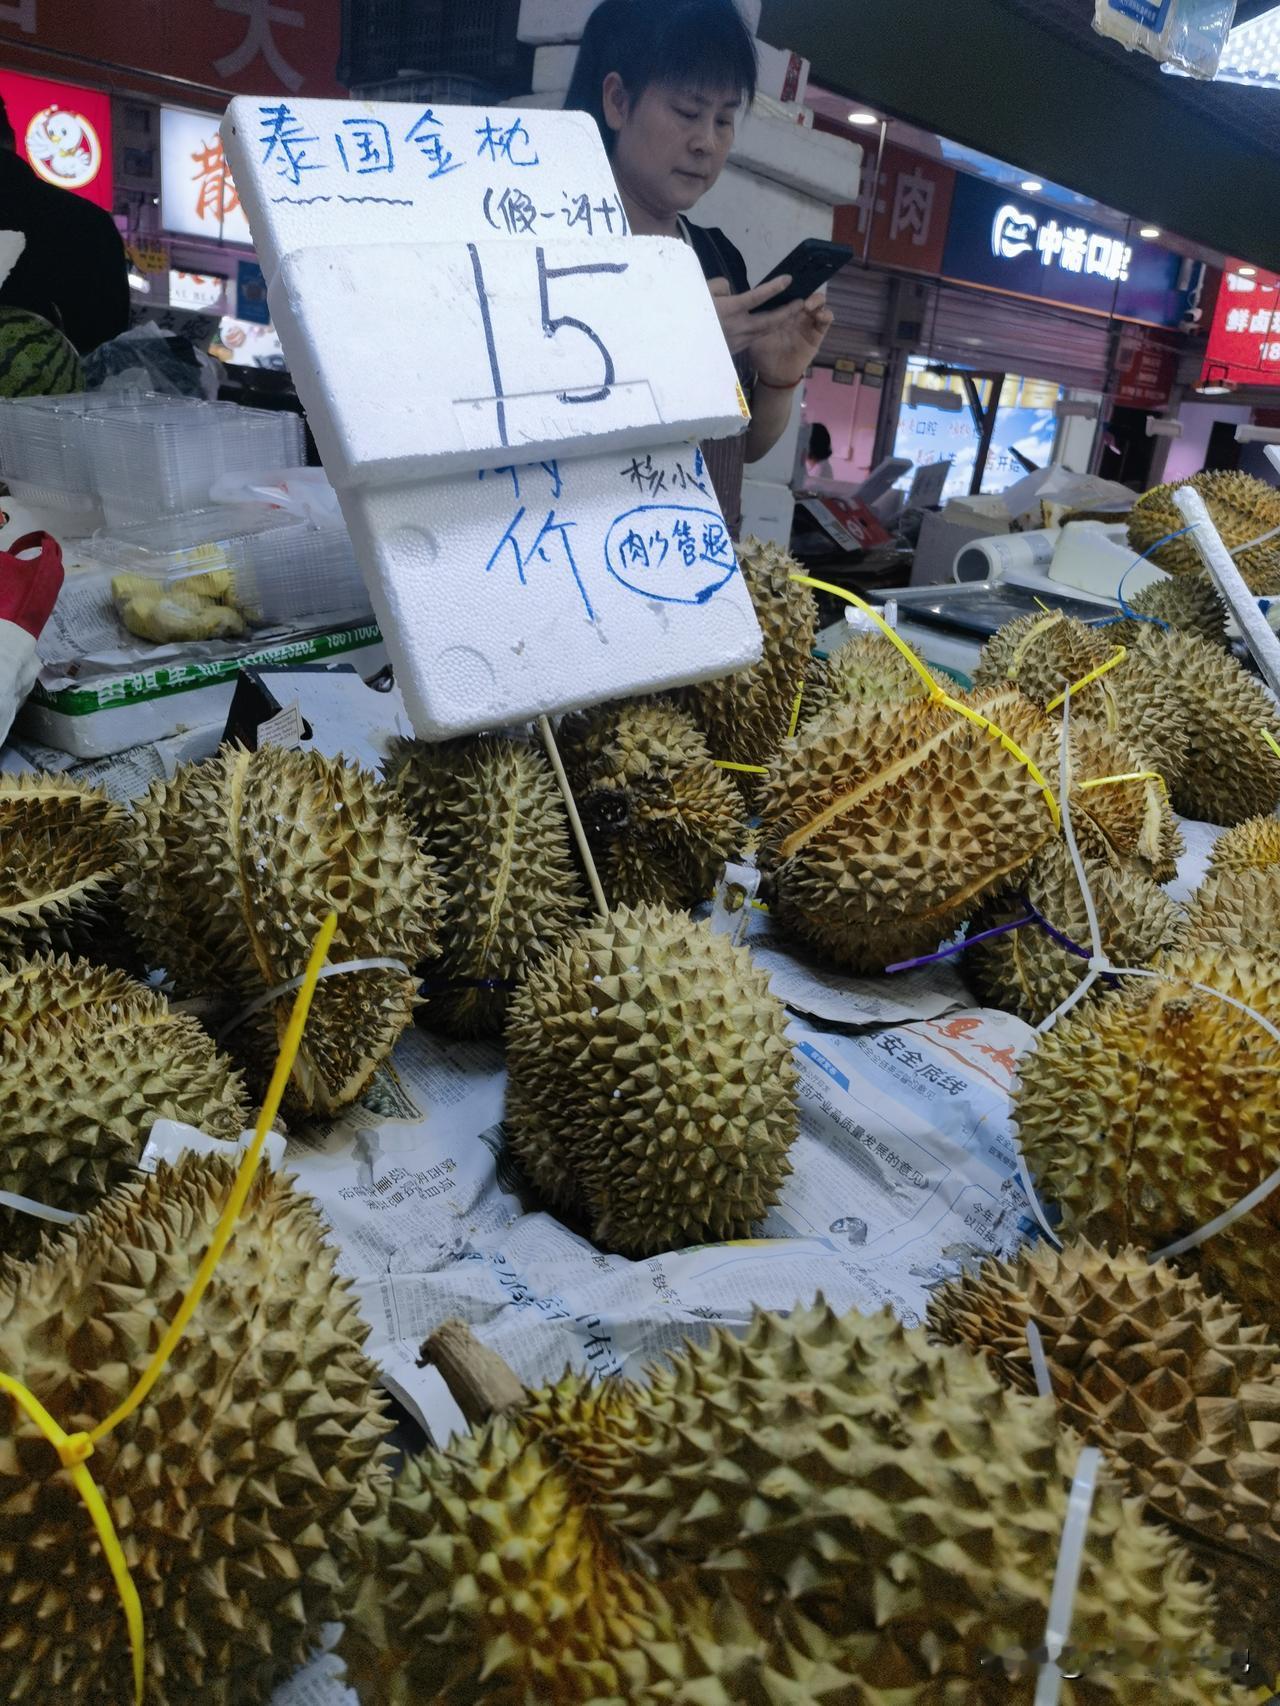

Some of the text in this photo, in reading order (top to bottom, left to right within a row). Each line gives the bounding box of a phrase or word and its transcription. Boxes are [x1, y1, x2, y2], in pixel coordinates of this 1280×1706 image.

[259, 103, 540, 186] 泰国金枕
[466, 242, 629, 447] 15
[478, 459, 595, 621] 价
